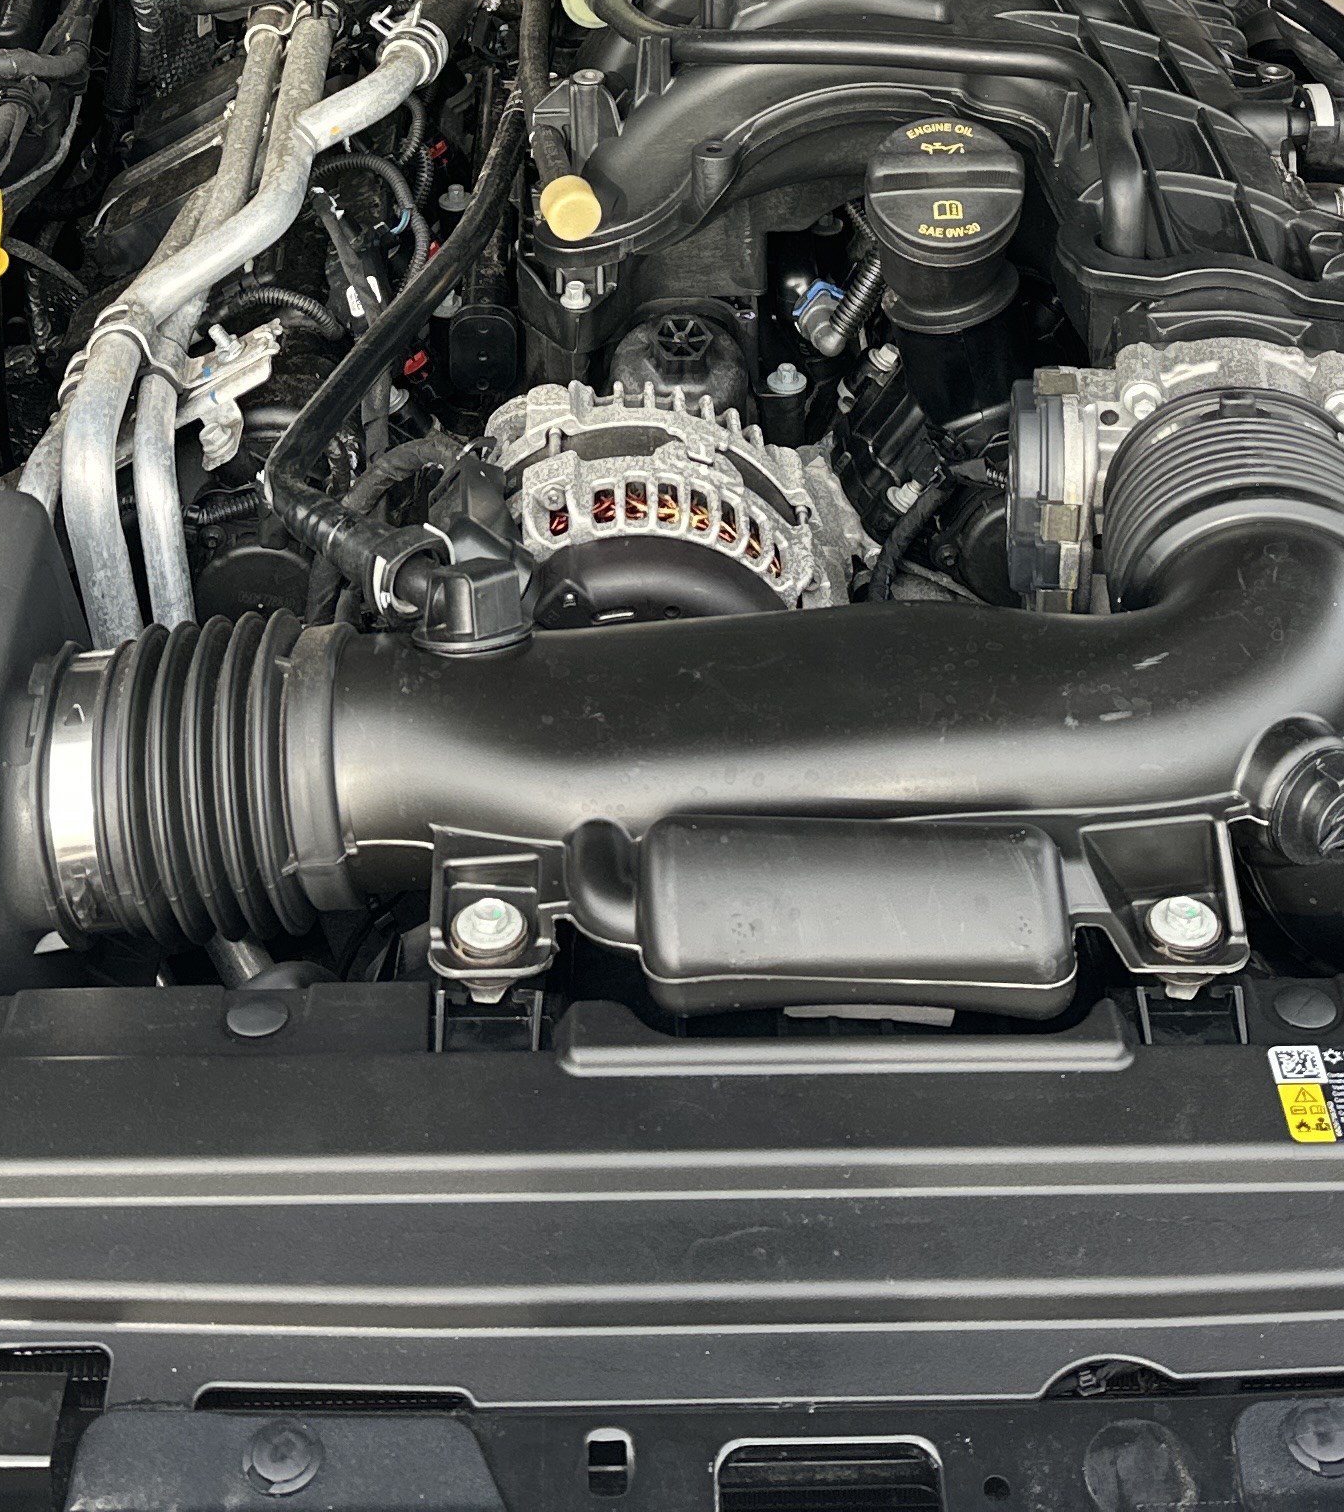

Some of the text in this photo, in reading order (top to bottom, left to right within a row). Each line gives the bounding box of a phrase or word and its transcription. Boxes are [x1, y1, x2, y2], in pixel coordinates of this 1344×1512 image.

[906, 123, 975, 139] ENGINE OIL
[918, 222, 981, 238] SAE 0W-20
